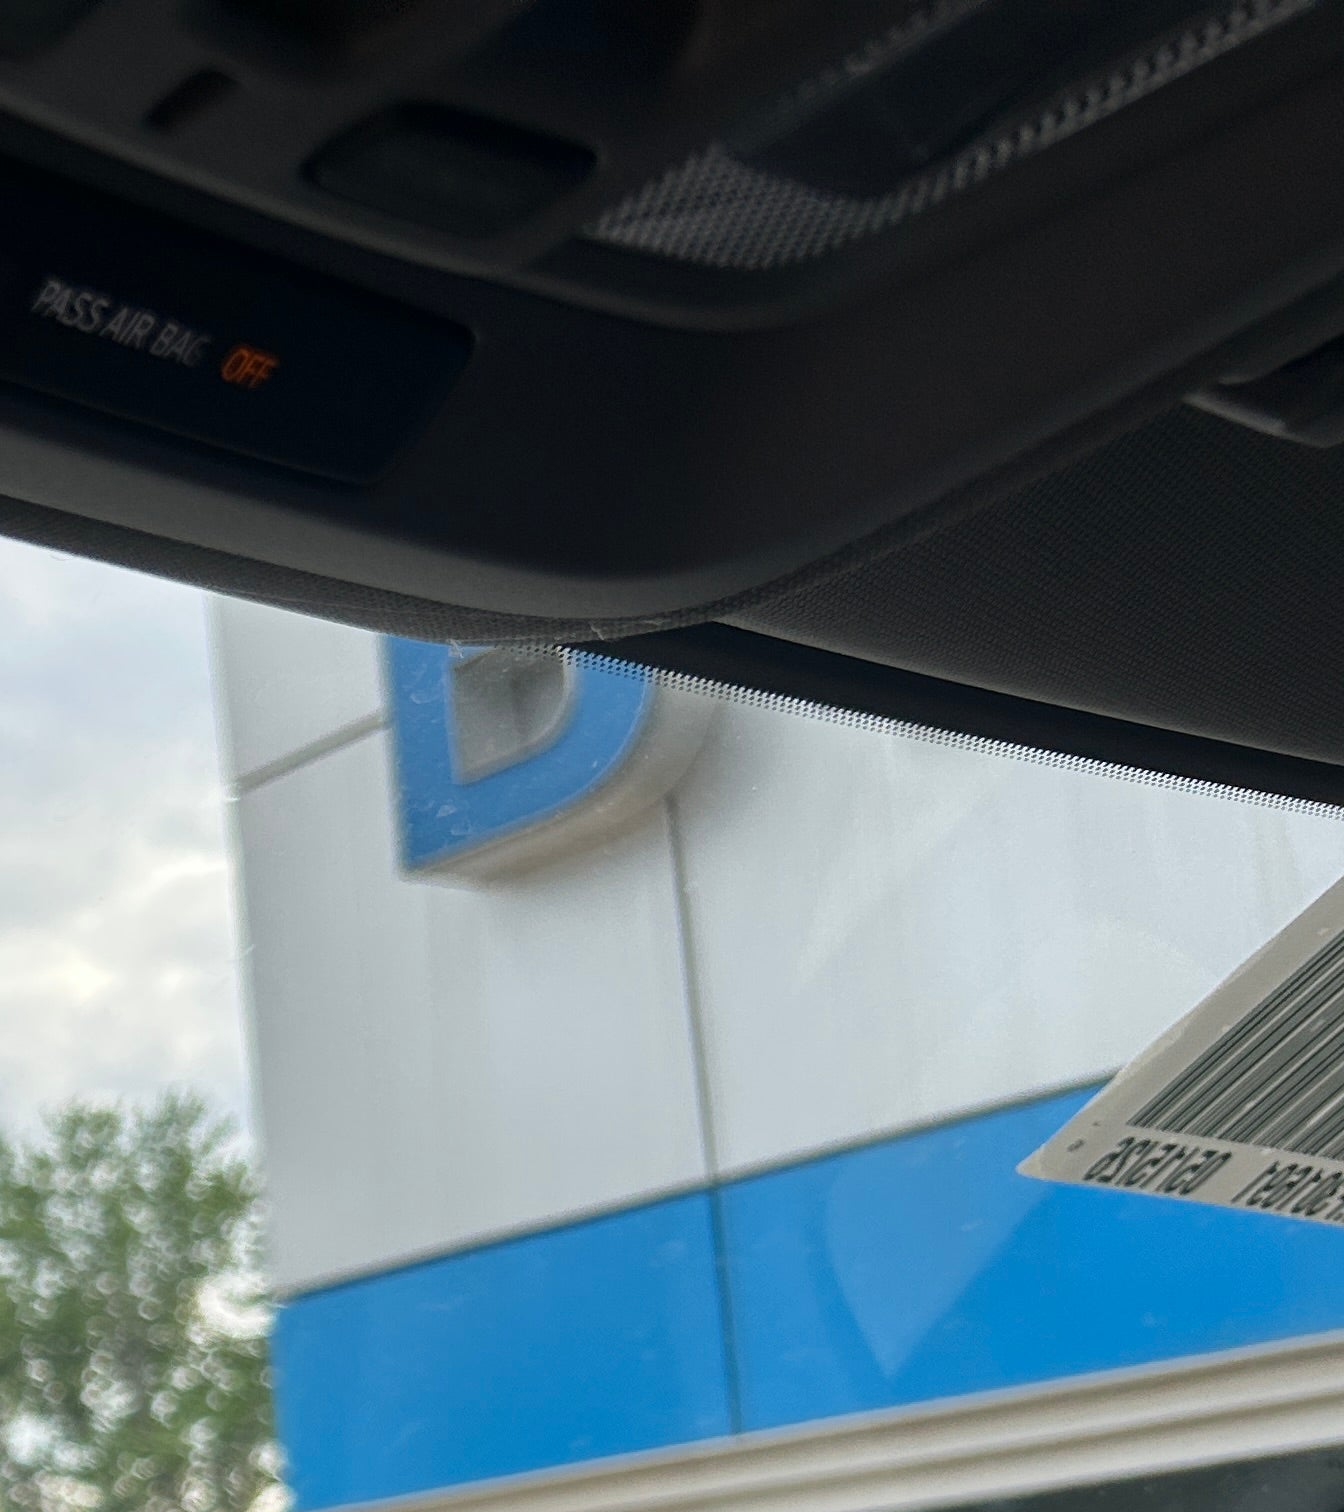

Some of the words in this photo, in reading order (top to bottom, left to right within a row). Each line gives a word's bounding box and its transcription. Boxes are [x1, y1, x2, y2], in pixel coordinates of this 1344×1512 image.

[31, 279, 108, 333] PASS
[99, 307, 156, 350] AIR
[150, 322, 209, 367] BAG
[220, 344, 281, 387] OFF
